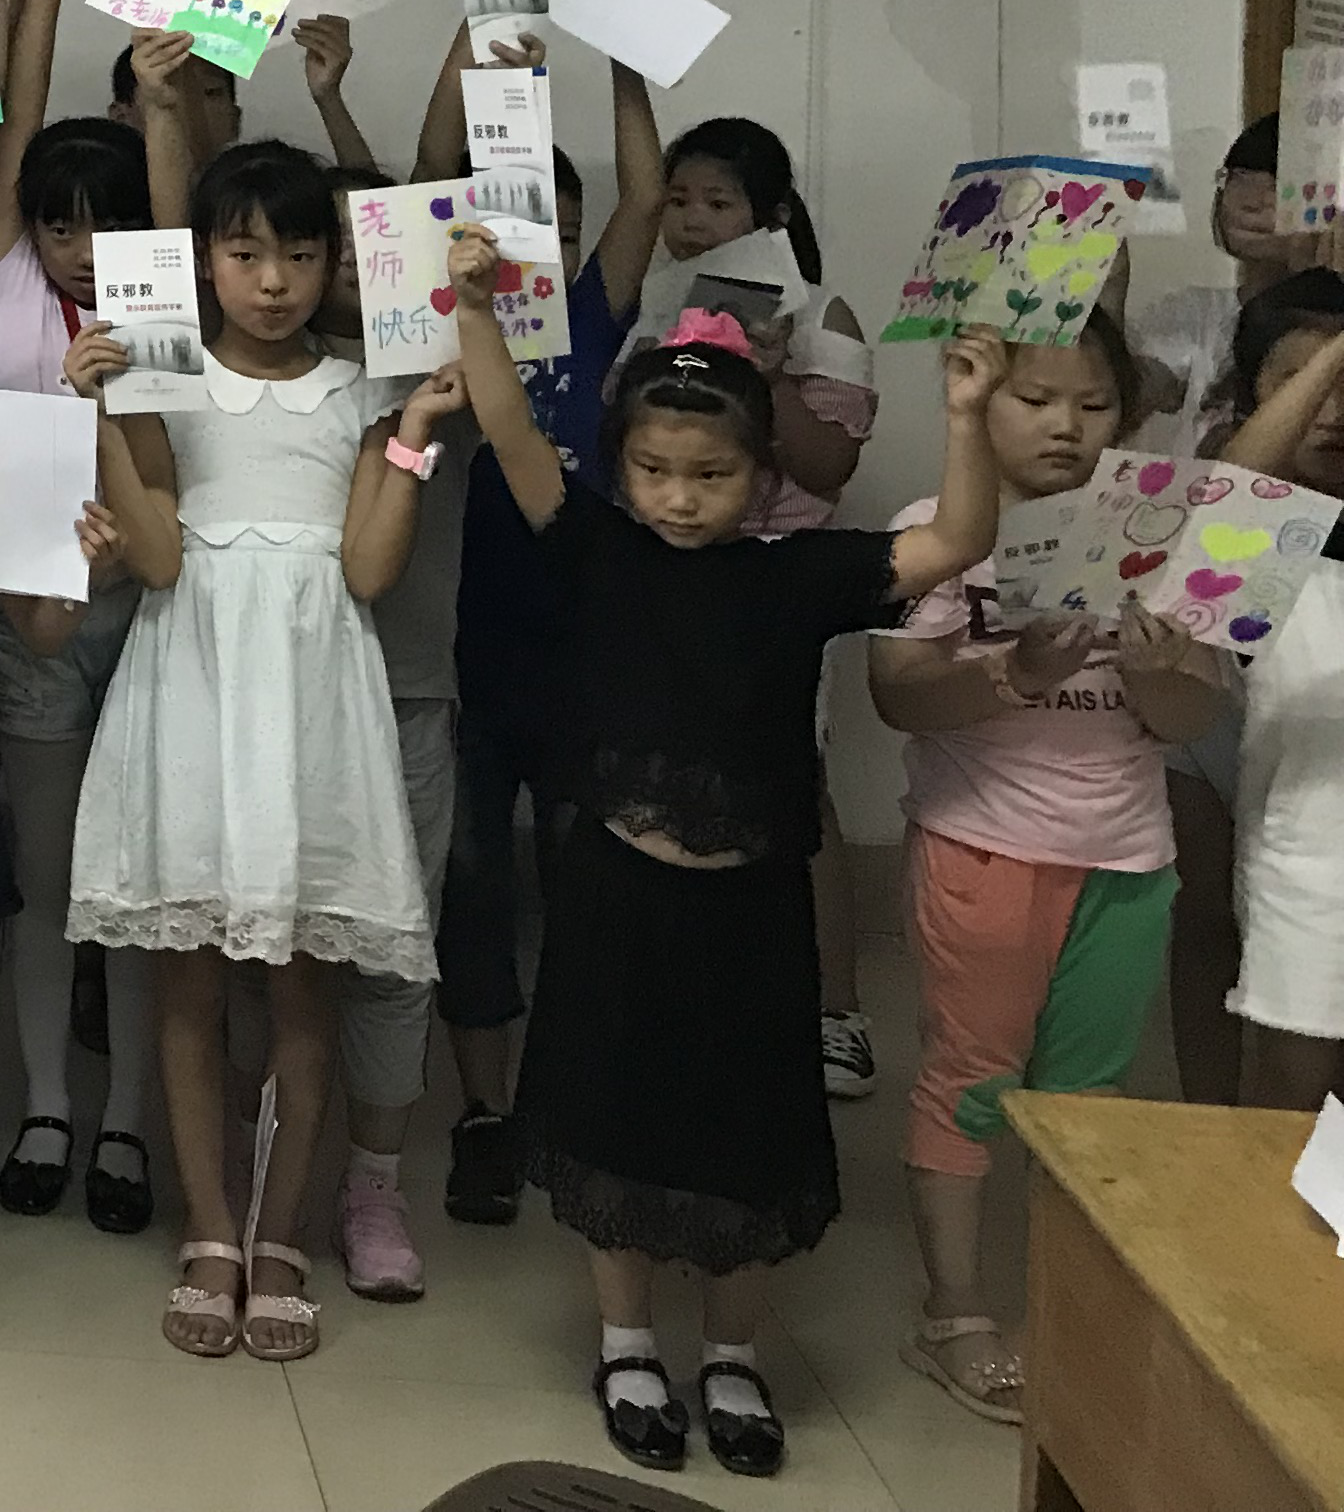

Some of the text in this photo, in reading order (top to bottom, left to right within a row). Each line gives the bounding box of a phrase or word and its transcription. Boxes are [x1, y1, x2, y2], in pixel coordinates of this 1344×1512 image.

[473, 124, 509, 139] 反邪教
[106, 283, 154, 299] 反邪教
[372, 305, 439, 350] 快乐
